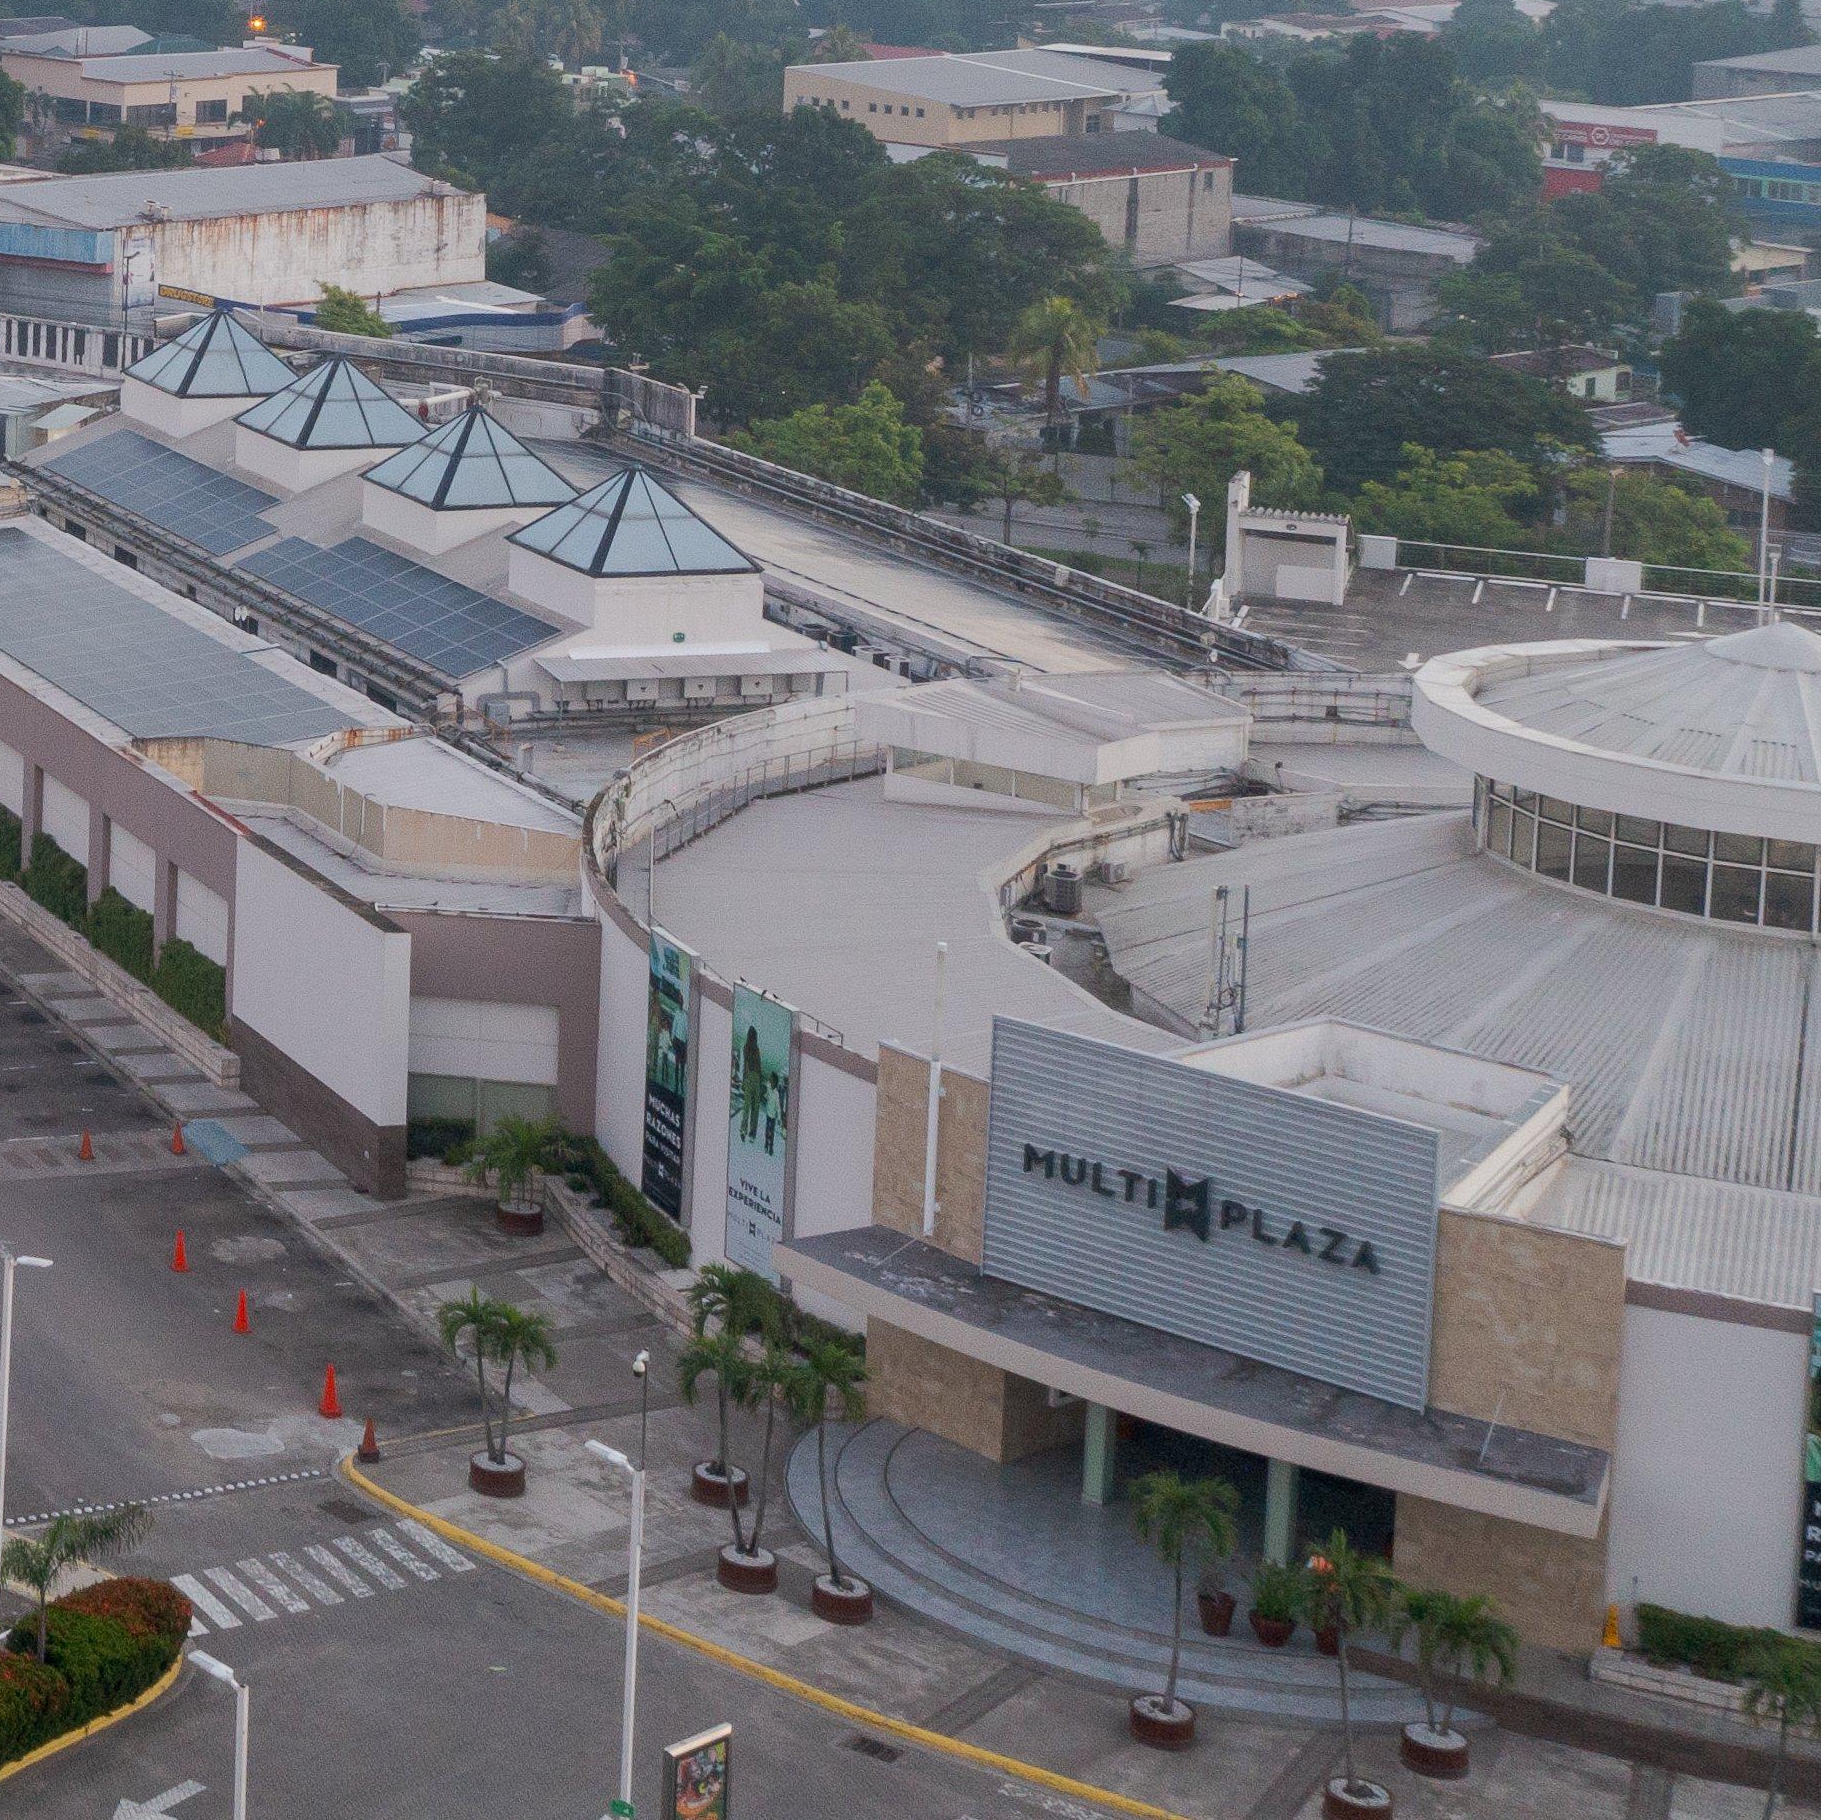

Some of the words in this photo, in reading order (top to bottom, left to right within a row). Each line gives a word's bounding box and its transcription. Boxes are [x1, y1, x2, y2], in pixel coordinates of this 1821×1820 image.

[729, 1186, 783, 1226] EXPERIENCIA
[740, 1178, 758, 1197] VIVE
[760, 1190, 771, 1204] LA
[1023, 1143, 1157, 1210] MULTI
[1220, 1200, 1381, 1275] PLAZA
